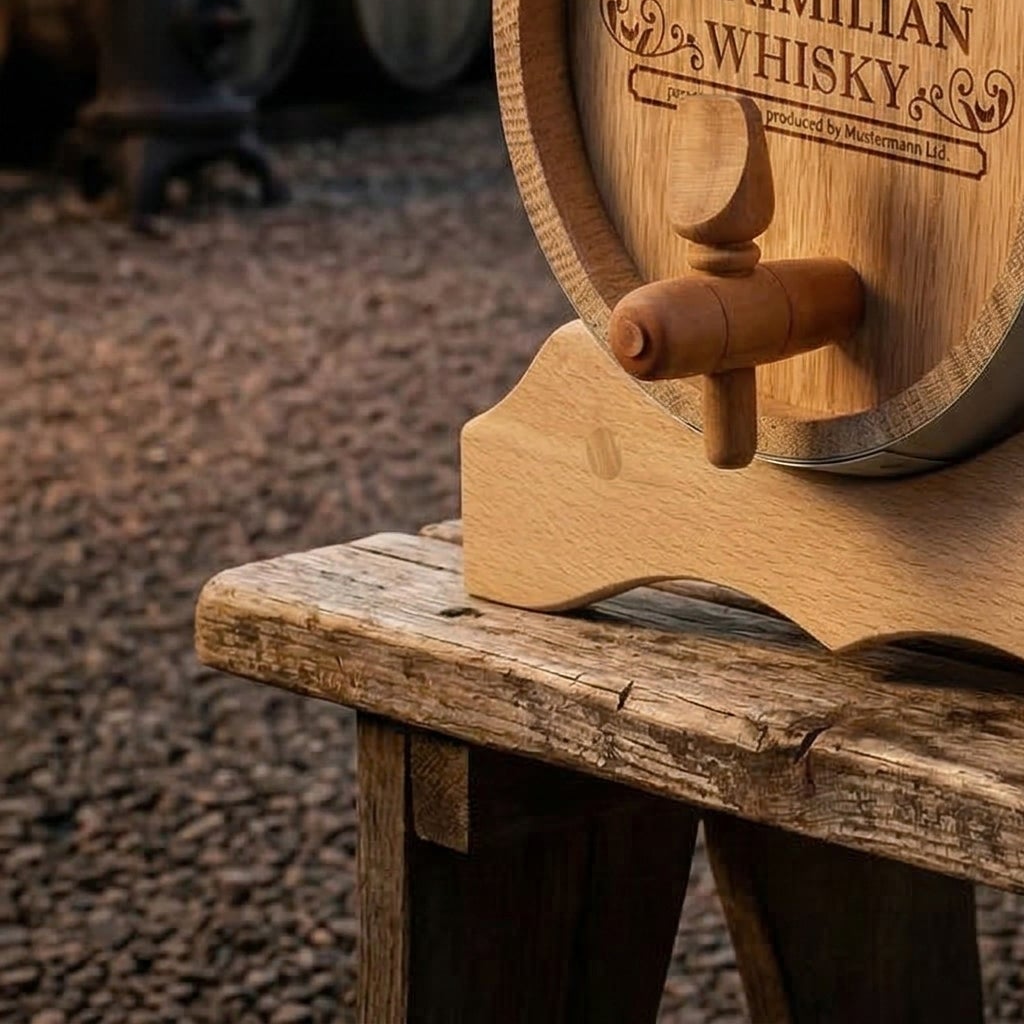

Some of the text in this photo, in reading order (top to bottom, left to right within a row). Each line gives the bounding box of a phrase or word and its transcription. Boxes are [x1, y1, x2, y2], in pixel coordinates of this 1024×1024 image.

[704, 20, 910, 110] WHISKY
[766, 107, 951, 162] produced by Mustermann Ltd.
